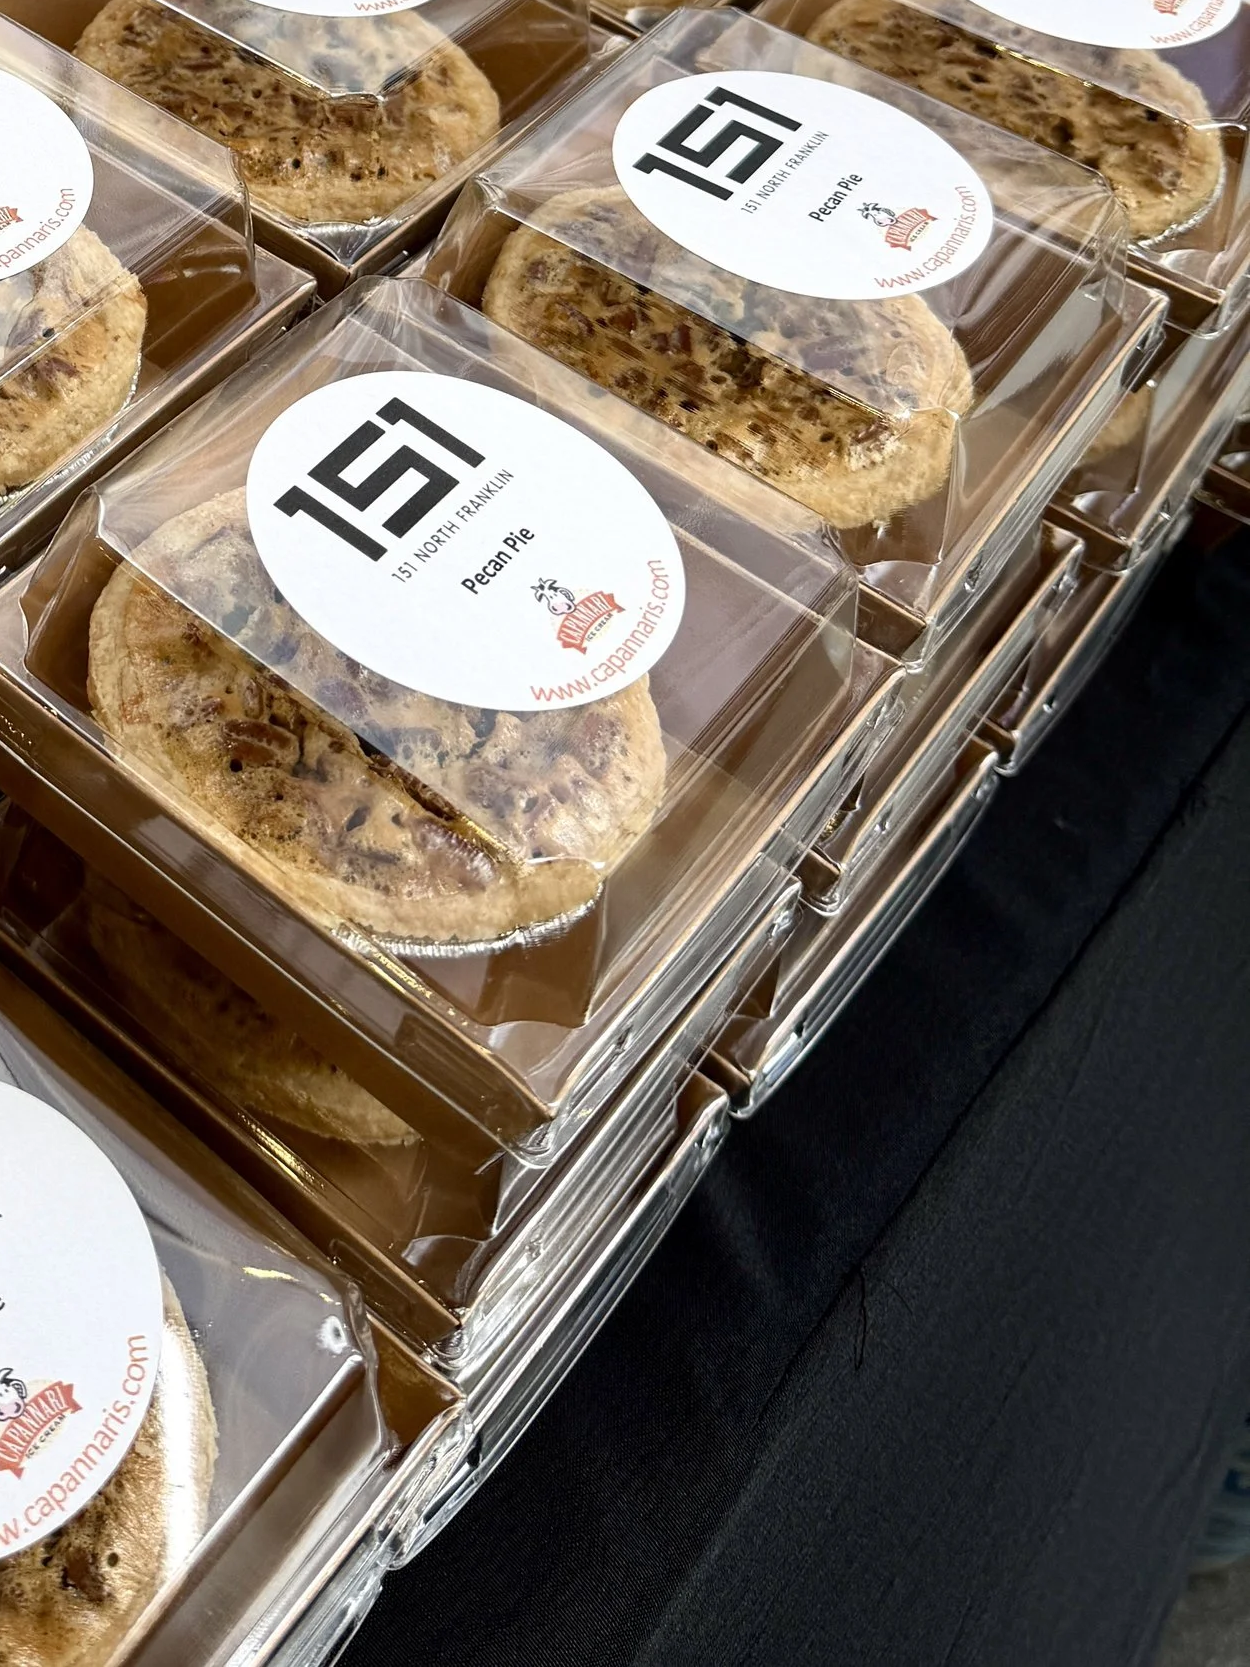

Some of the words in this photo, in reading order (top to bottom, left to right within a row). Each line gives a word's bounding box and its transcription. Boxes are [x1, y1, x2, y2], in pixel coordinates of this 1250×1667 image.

[634, 87, 801, 200] 151
[741, 200, 761, 214] 151
[756, 170, 791, 199] NORTH
[785, 130, 829, 169] FRANKLIN
[807, 191, 847, 222] Pecan
[836, 174, 863, 191] Pie
[874, 185, 978, 289] www.capannaris.com
[274, 398, 485, 561] 151
[393, 561, 417, 579] 151
[414, 521, 459, 561] NORTH
[455, 469, 513, 522] FRANKLIN
[461, 551, 513, 593] Pecan
[503, 529, 535, 553] Pie
[530, 560, 669, 702] www.capannaris.com
